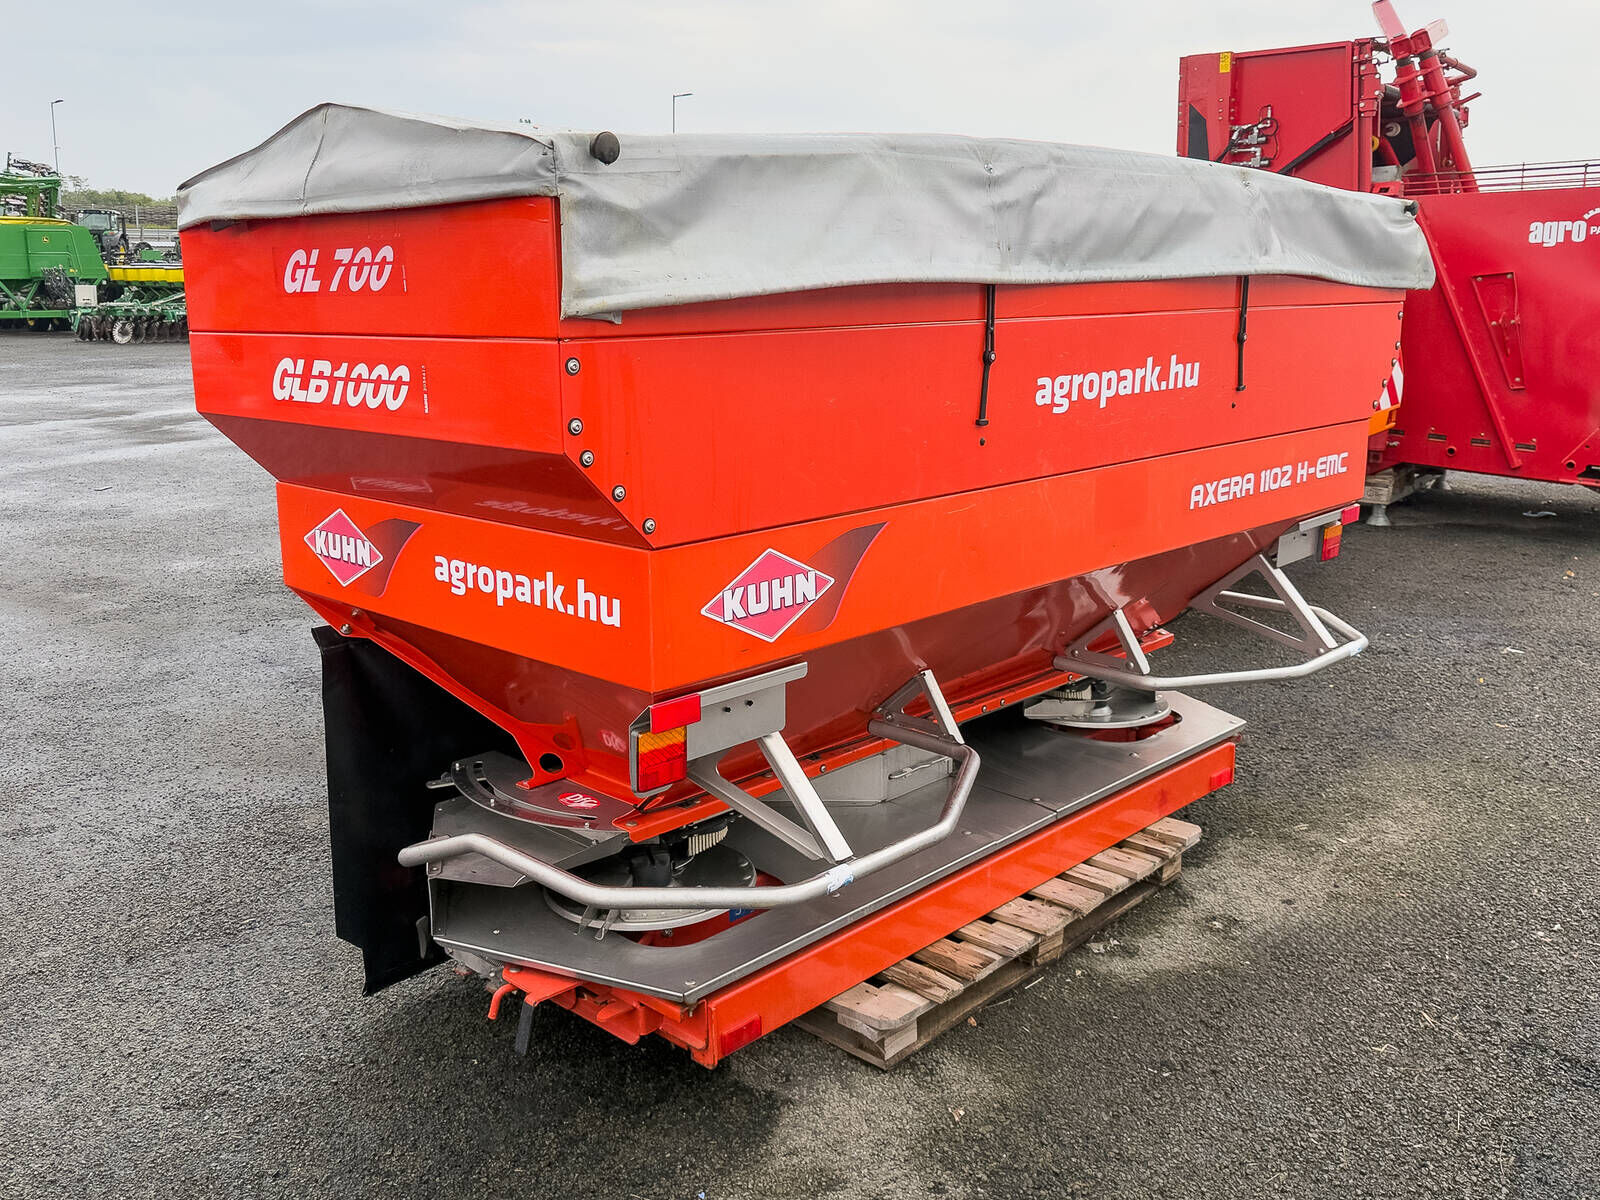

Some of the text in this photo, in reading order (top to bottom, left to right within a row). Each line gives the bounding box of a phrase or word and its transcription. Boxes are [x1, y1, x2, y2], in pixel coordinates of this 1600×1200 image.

[1528, 220, 1587, 248] agro
[283, 248, 322, 294] GL
[329, 245, 394, 292] 700
[1035, 354, 1200, 414] agropark.hu
[1189, 451, 1349, 510] AXERA 1102 H-EMC
[314, 529, 372, 568] KUHN
[434, 554, 621, 628] agropark.hu
[722, 569, 817, 622] KUHN
